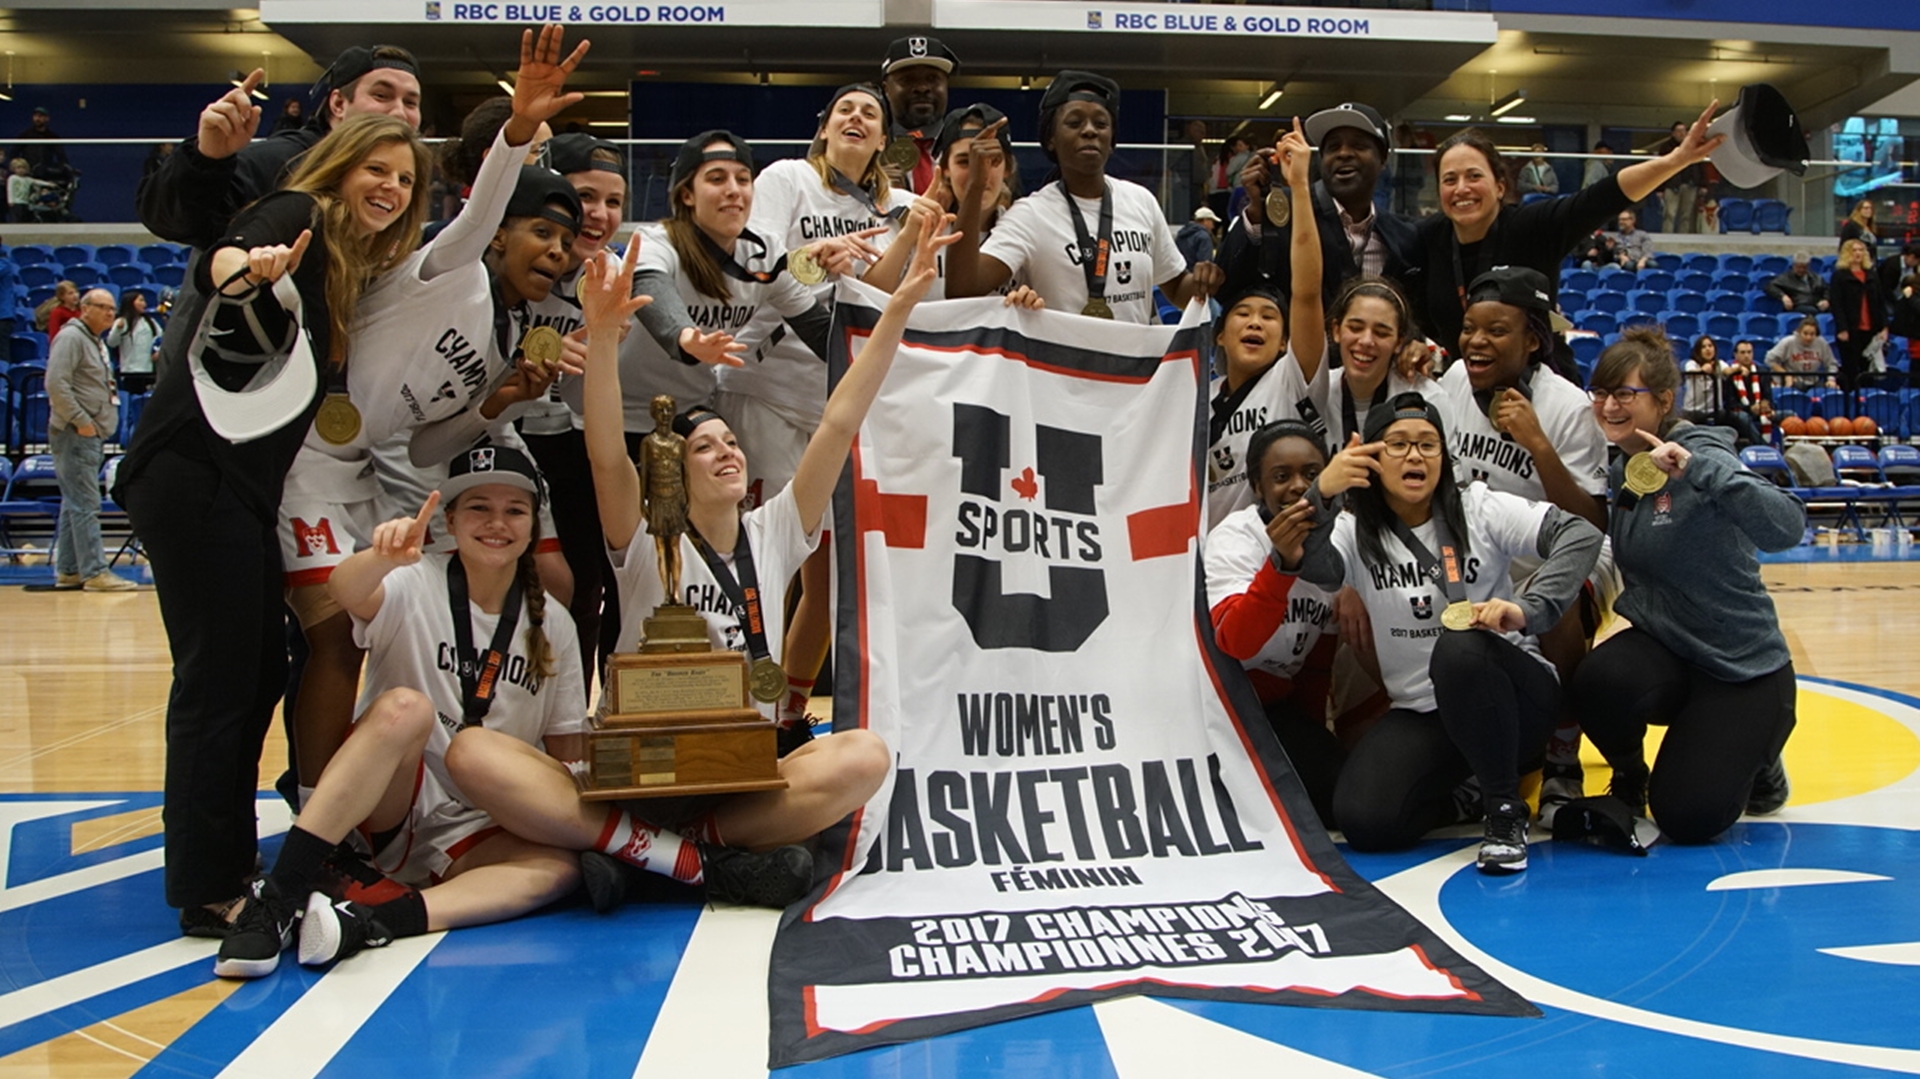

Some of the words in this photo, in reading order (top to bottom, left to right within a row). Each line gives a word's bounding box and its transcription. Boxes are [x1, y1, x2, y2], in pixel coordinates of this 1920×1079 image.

[454, 3, 499, 21] RBC
[505, 4, 562, 21] BLUE
[567, 6, 583, 22] &
[589, 5, 650, 22] GOLD
[657, 5, 725, 22] ROOM
[1115, 13, 1158, 30] RBC
[1164, 14, 1218, 31] BLUE
[1223, 16, 1238, 32] &
[1243, 16, 1301, 33] GOLD
[1307, 18, 1370, 35] ROOM
[800, 215, 880, 239] CHAMPION
[955, 500, 1103, 562] SPORTS
[957, 691, 1117, 758] WOMEN'S
[990, 865, 1144, 893] FÉMININ
[911, 914, 1011, 946] 2017
[1024, 893, 1286, 941] CHAMPIONS
[888, 931, 1229, 979] CHAMPIONNES
